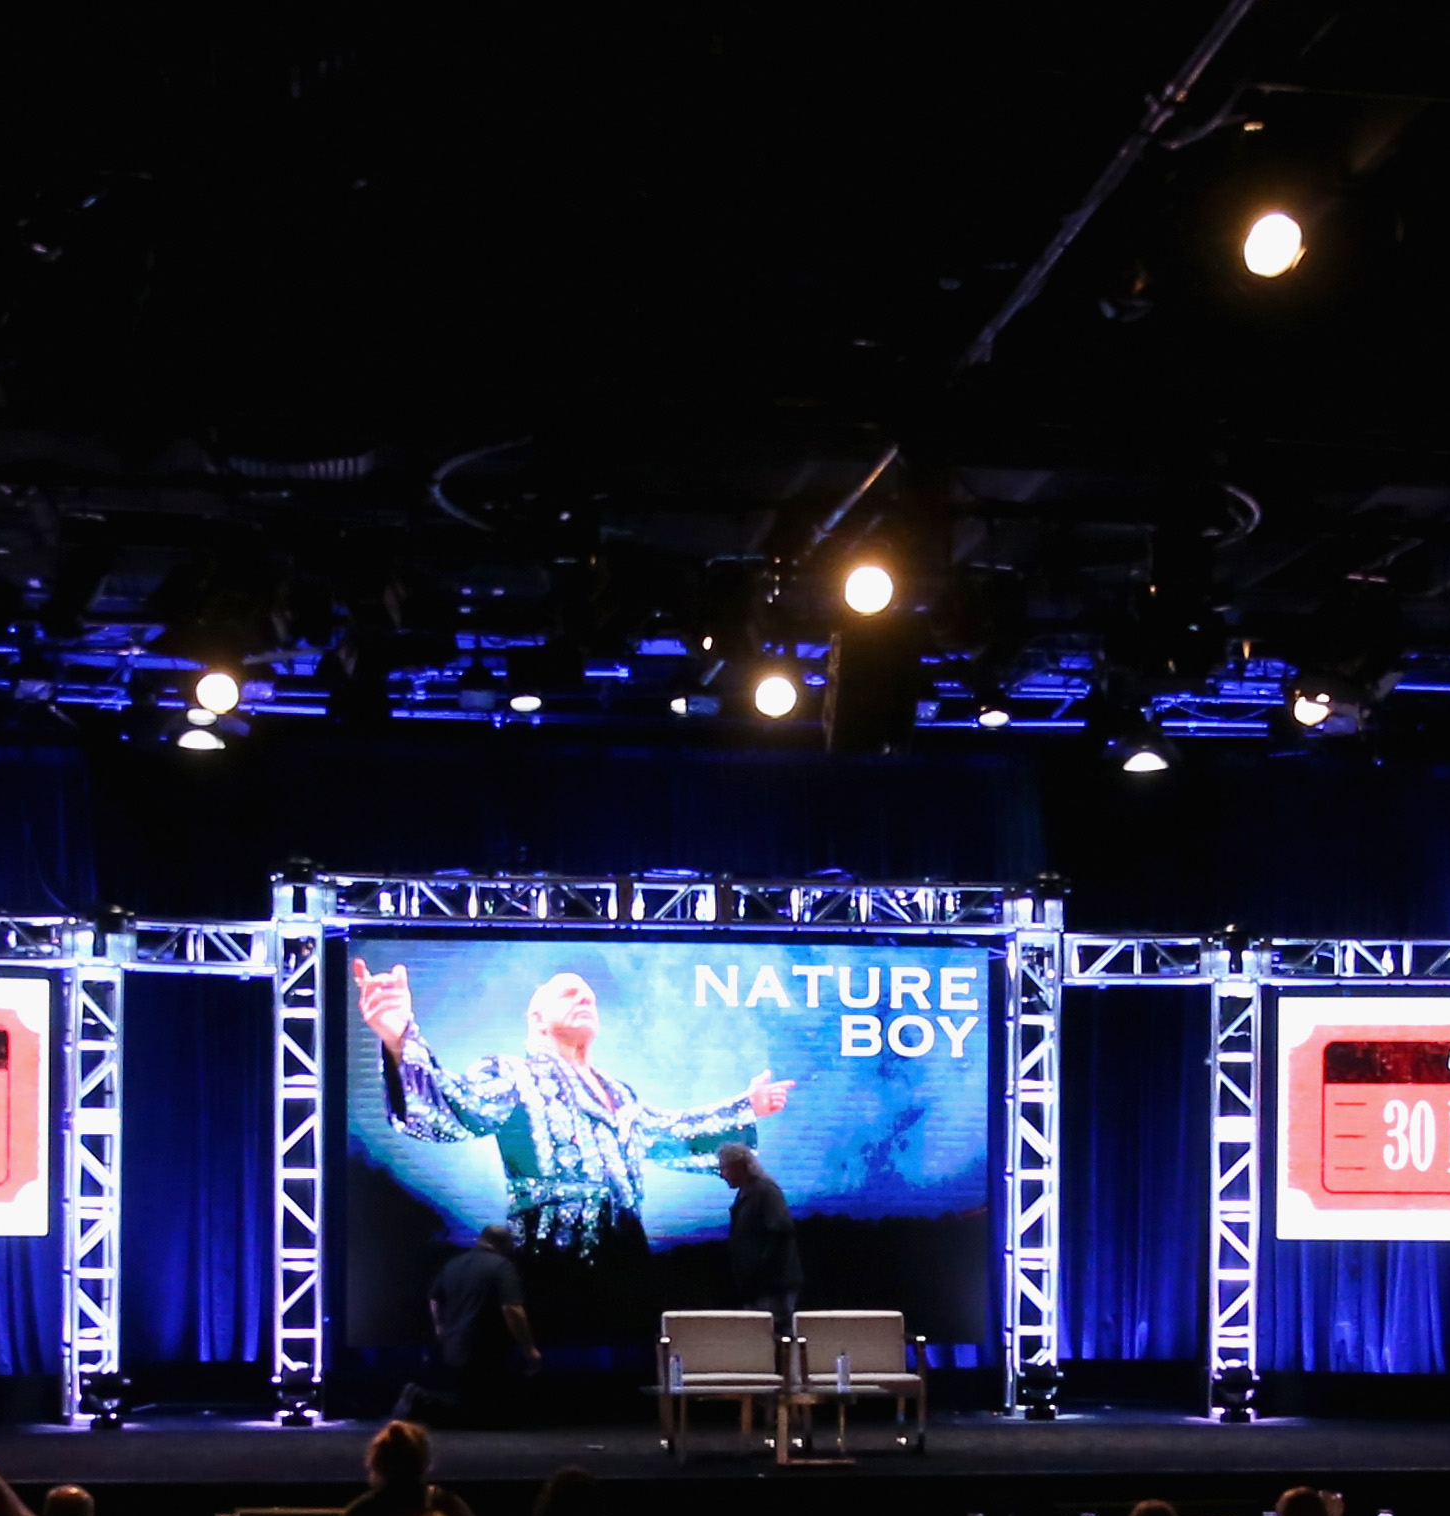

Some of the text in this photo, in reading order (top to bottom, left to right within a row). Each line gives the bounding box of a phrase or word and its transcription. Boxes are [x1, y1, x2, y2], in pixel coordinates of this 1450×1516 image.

[694, 963, 978, 1011] NATURE
[840, 1014, 978, 1058] BOY
[1383, 1099, 1436, 1172] 30
